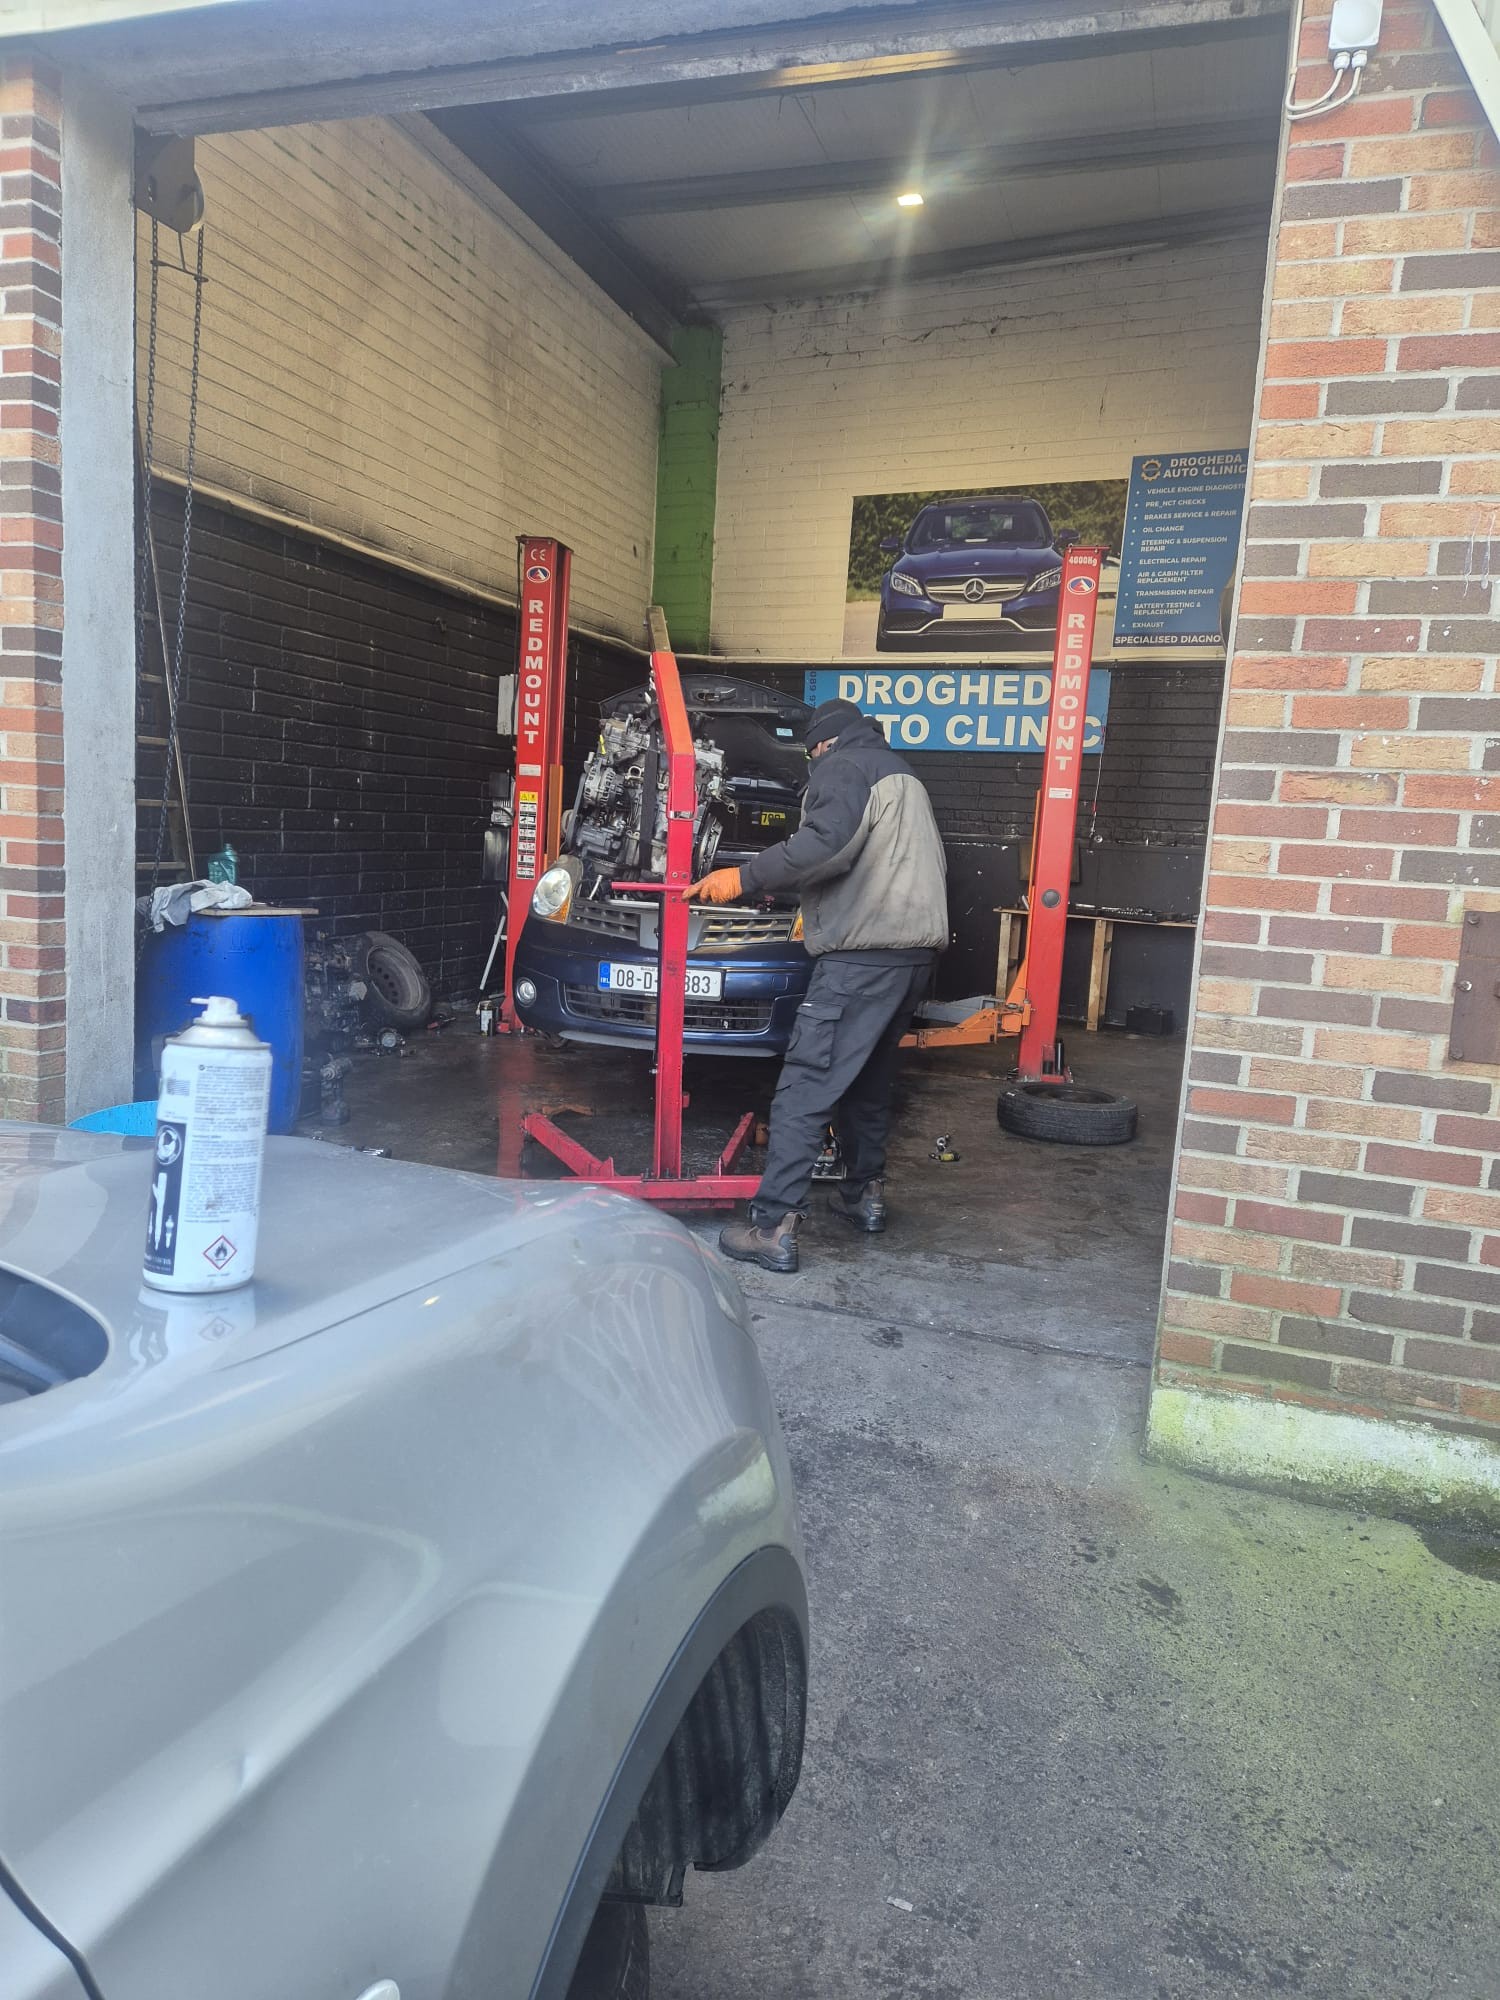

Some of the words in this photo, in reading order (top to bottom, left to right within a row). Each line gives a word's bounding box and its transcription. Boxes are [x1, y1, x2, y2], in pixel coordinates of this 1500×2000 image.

[1170, 454, 1242, 468] DROGHEDA
[1163, 467, 1198, 478] AUTO
[1202, 464, 1247, 476] CLINIC
[1205, 483, 1245, 491] DIAGNOSTI
[1144, 512, 1172, 520] BRAKES
[1114, 635, 1178, 644] SPECIALISED
[1180, 635, 1221, 643] DIAGNO
[524, 599, 544, 744] REDMOUNT
[839, 674, 1052, 706] DROGHED
[1055, 613, 1085, 771] REDMOUNT
[863, 713, 930, 745] TO
[945, 714, 1101, 748] CLINC
